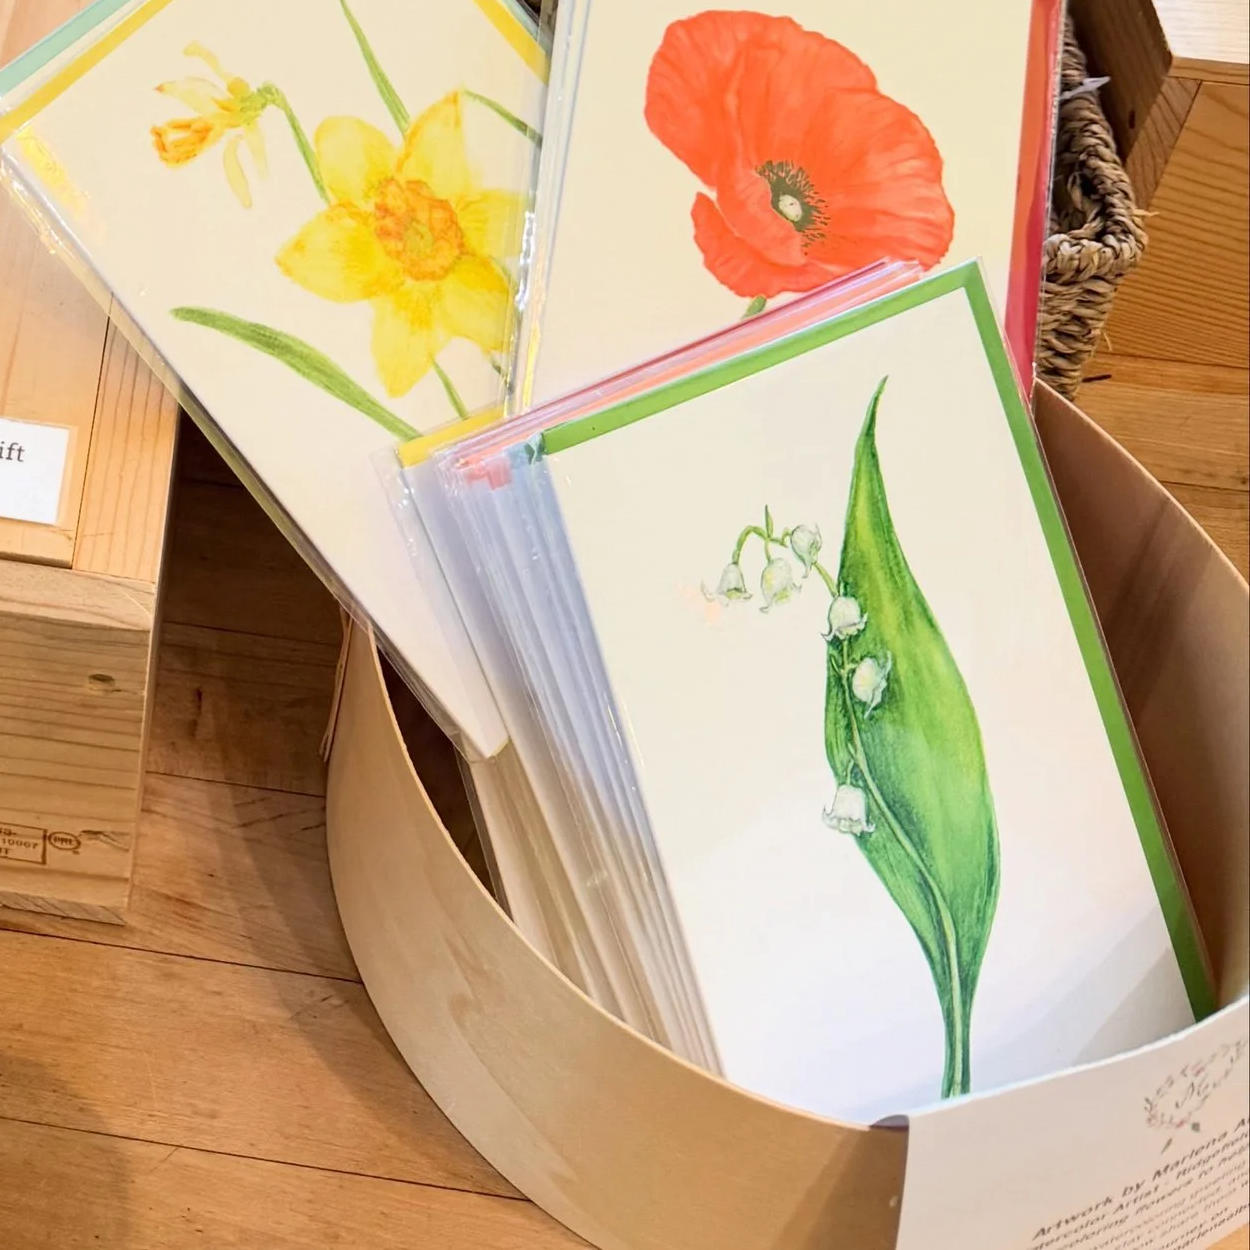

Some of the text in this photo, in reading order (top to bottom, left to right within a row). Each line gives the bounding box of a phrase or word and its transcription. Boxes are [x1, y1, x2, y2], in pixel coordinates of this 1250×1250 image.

[1032, 1196, 1112, 1242] Artwork
[1122, 1180, 1146, 1198] by
[1152, 1131, 1229, 1182] Marlena
